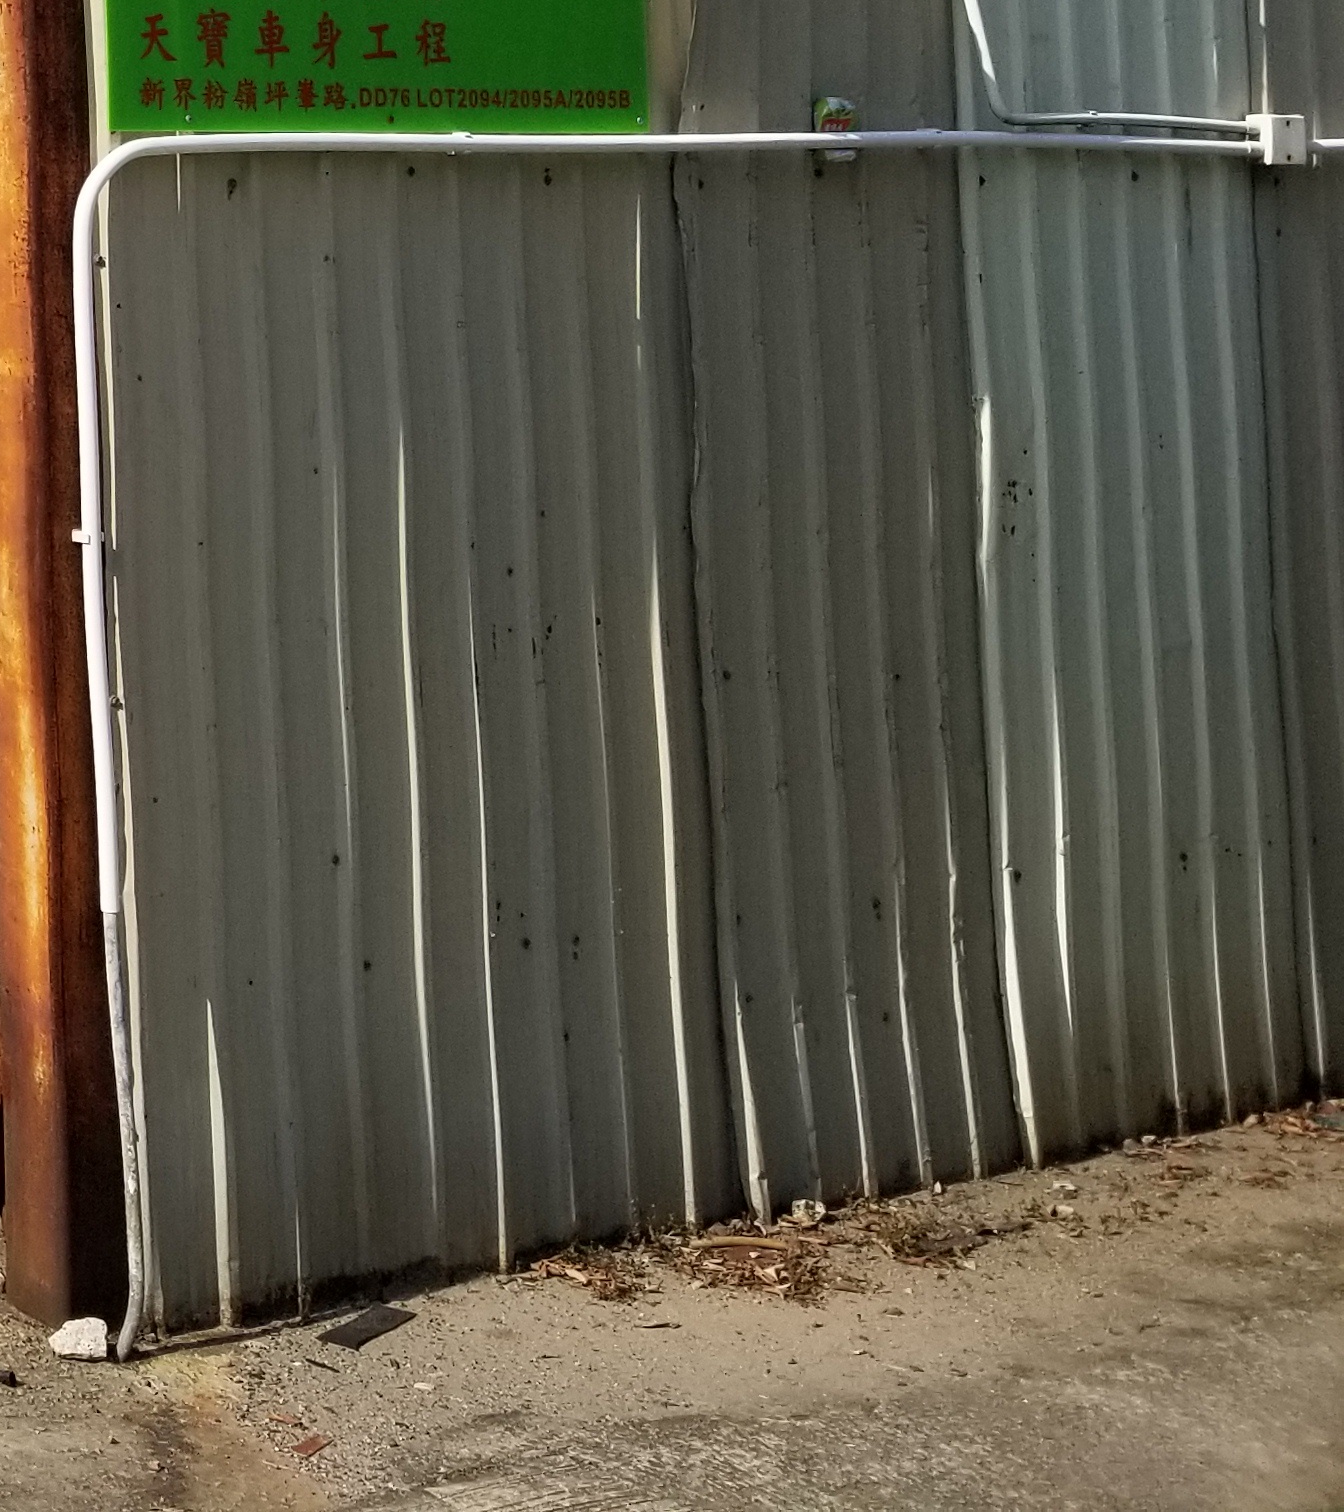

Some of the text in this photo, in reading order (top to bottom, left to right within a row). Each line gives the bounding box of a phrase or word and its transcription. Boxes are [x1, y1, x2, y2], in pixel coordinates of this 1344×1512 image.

[140, 8, 451, 69] 天寶車身工程
